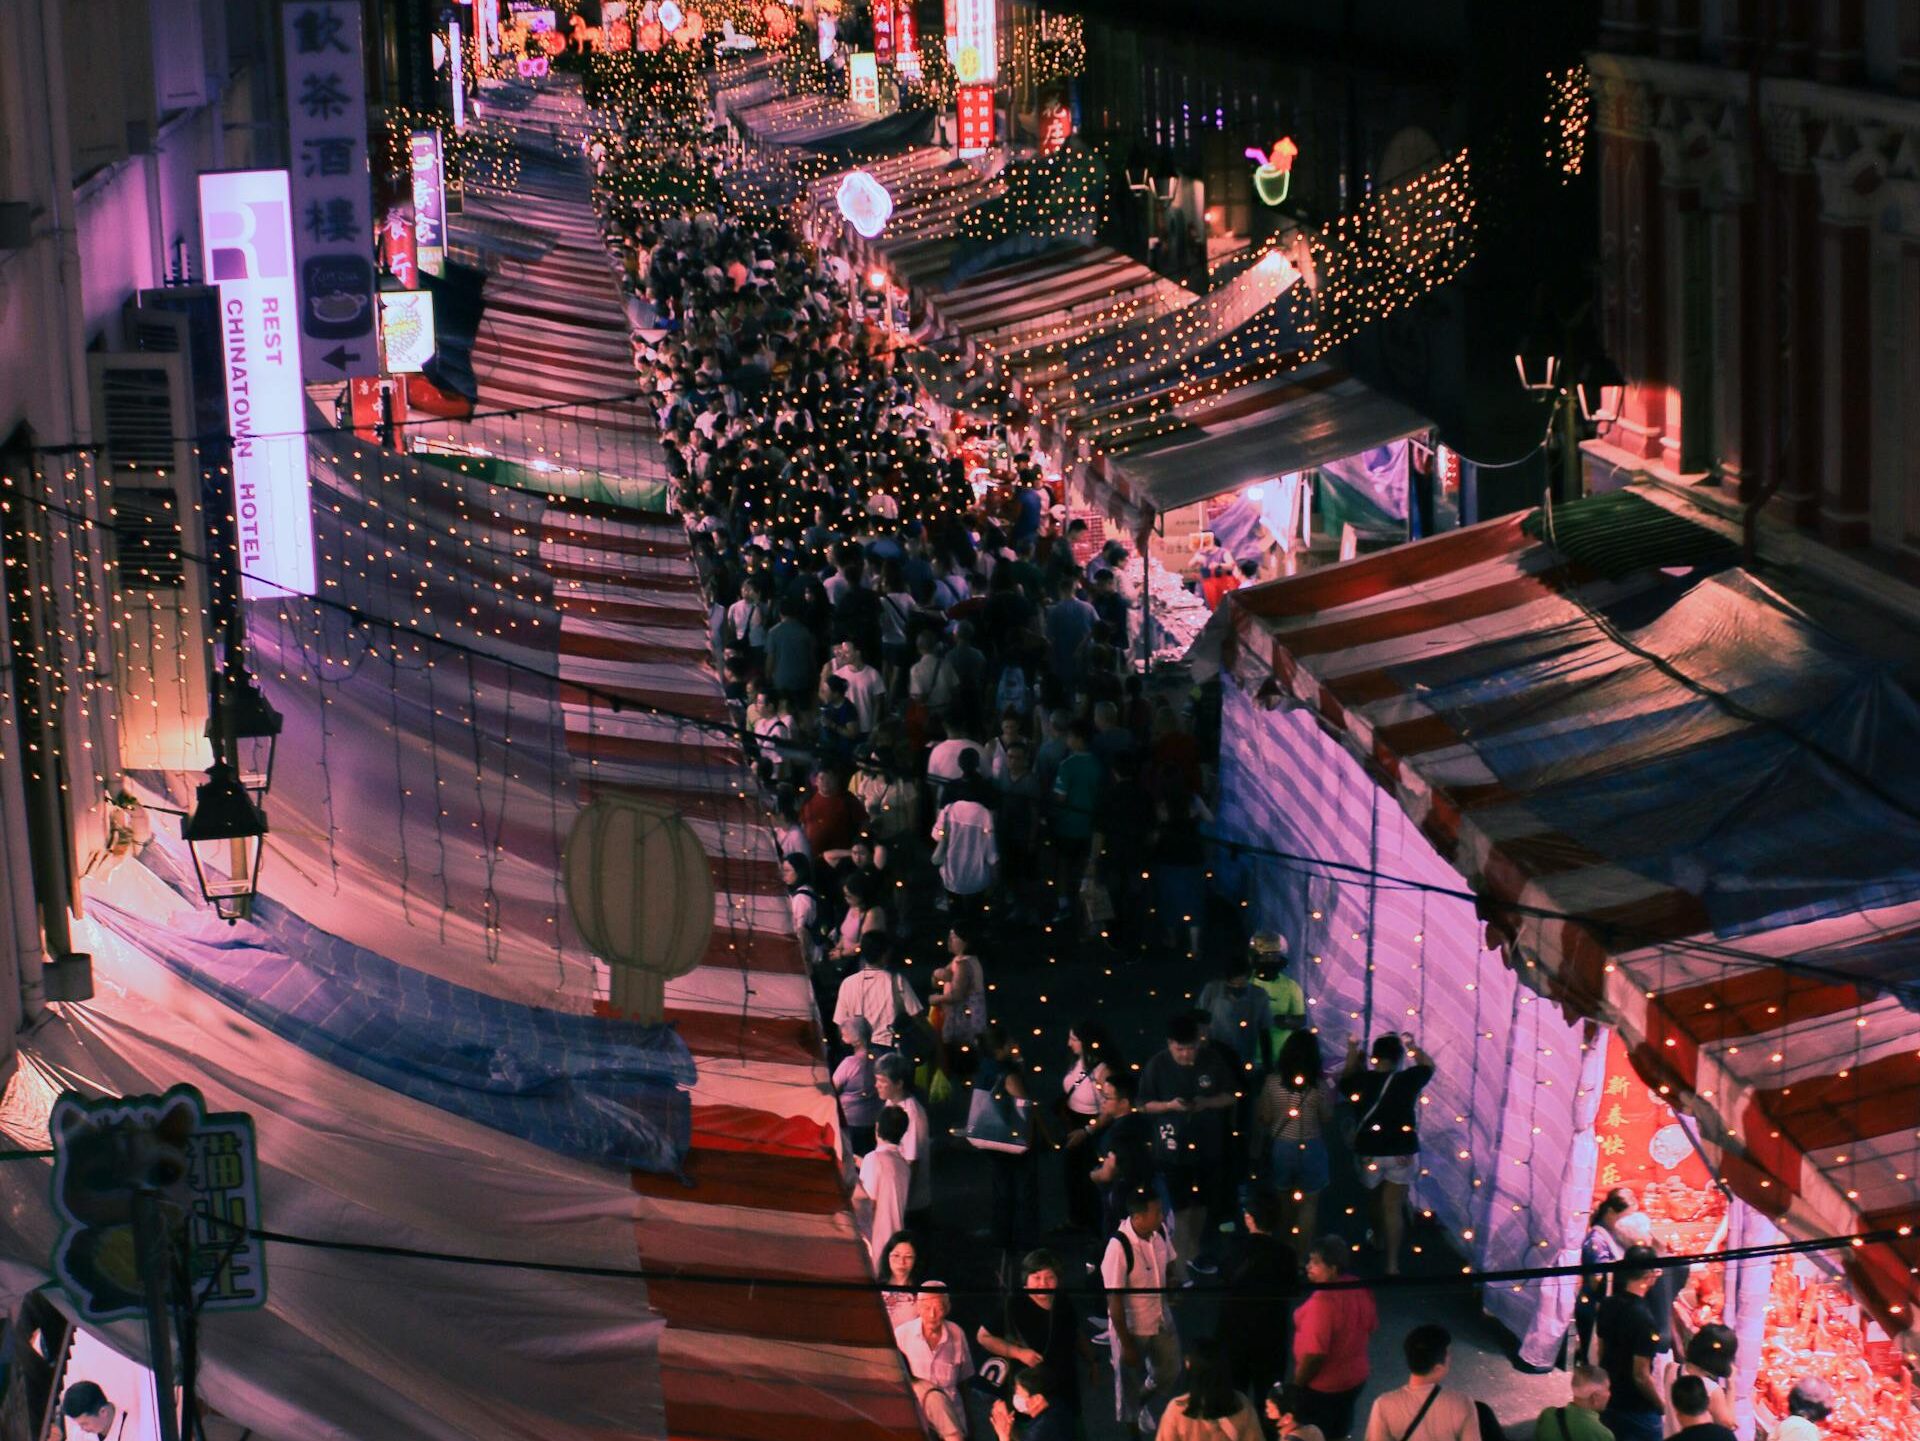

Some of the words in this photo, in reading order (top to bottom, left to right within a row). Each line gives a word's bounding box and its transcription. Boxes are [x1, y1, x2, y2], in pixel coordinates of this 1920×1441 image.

[227, 299, 253, 458] CHINATOWN
[262, 297, 282, 365] REST
[239, 483, 260, 569] HOTEL
[1601, 1075, 1631, 1185] 新春快乐
